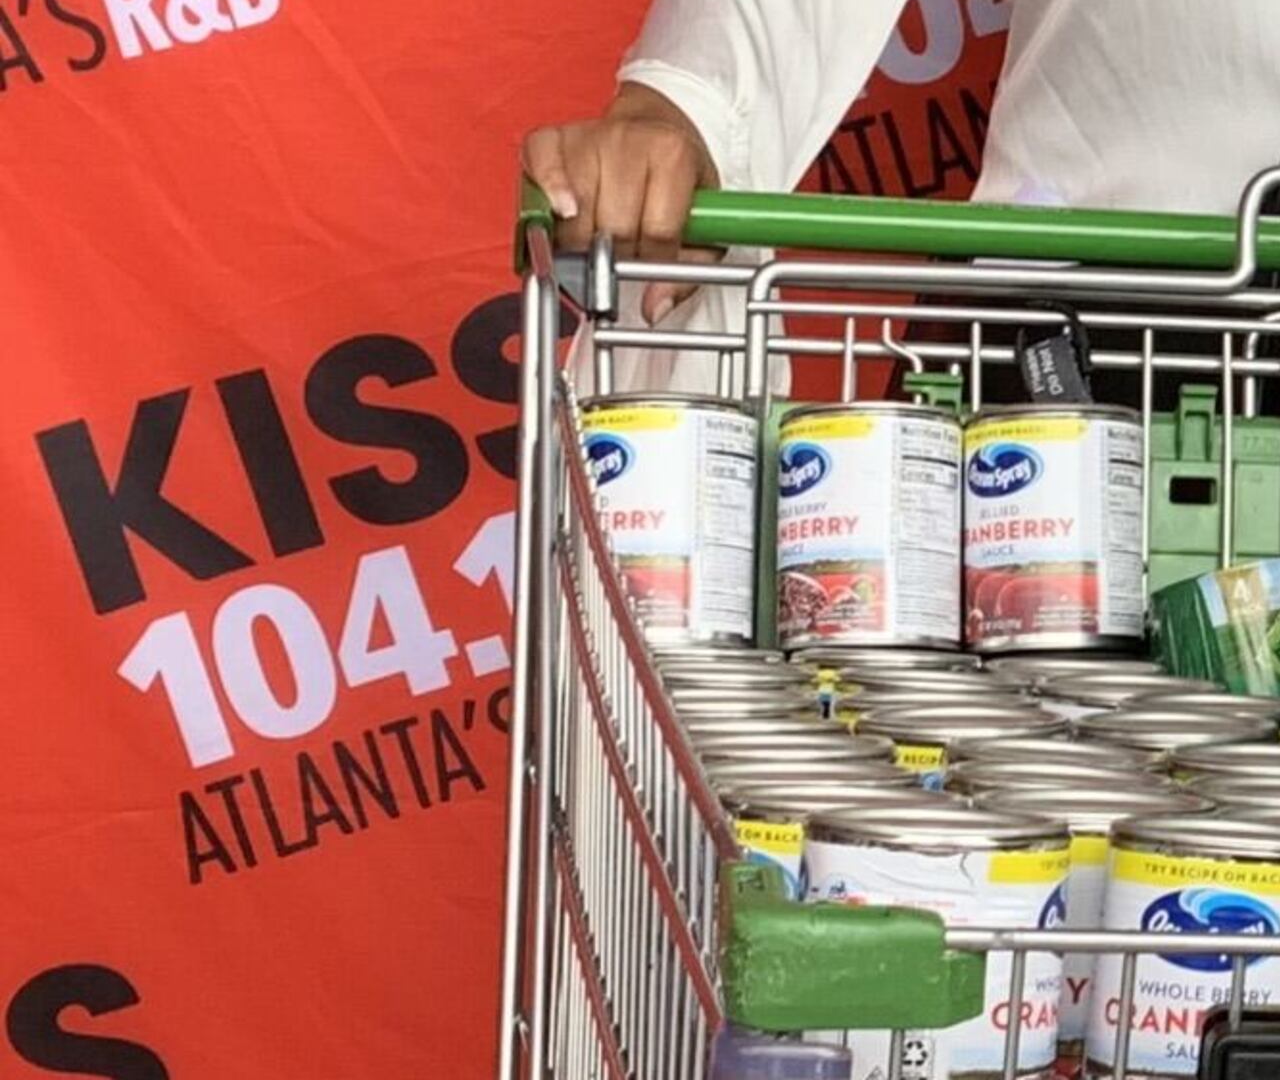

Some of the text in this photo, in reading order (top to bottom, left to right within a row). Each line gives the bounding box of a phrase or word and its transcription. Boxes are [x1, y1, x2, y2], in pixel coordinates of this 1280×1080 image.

[1144, 862, 1169, 877] TRY
[1170, 865, 1219, 881] RECIPE
[1138, 979, 1206, 1001] WHOLE
